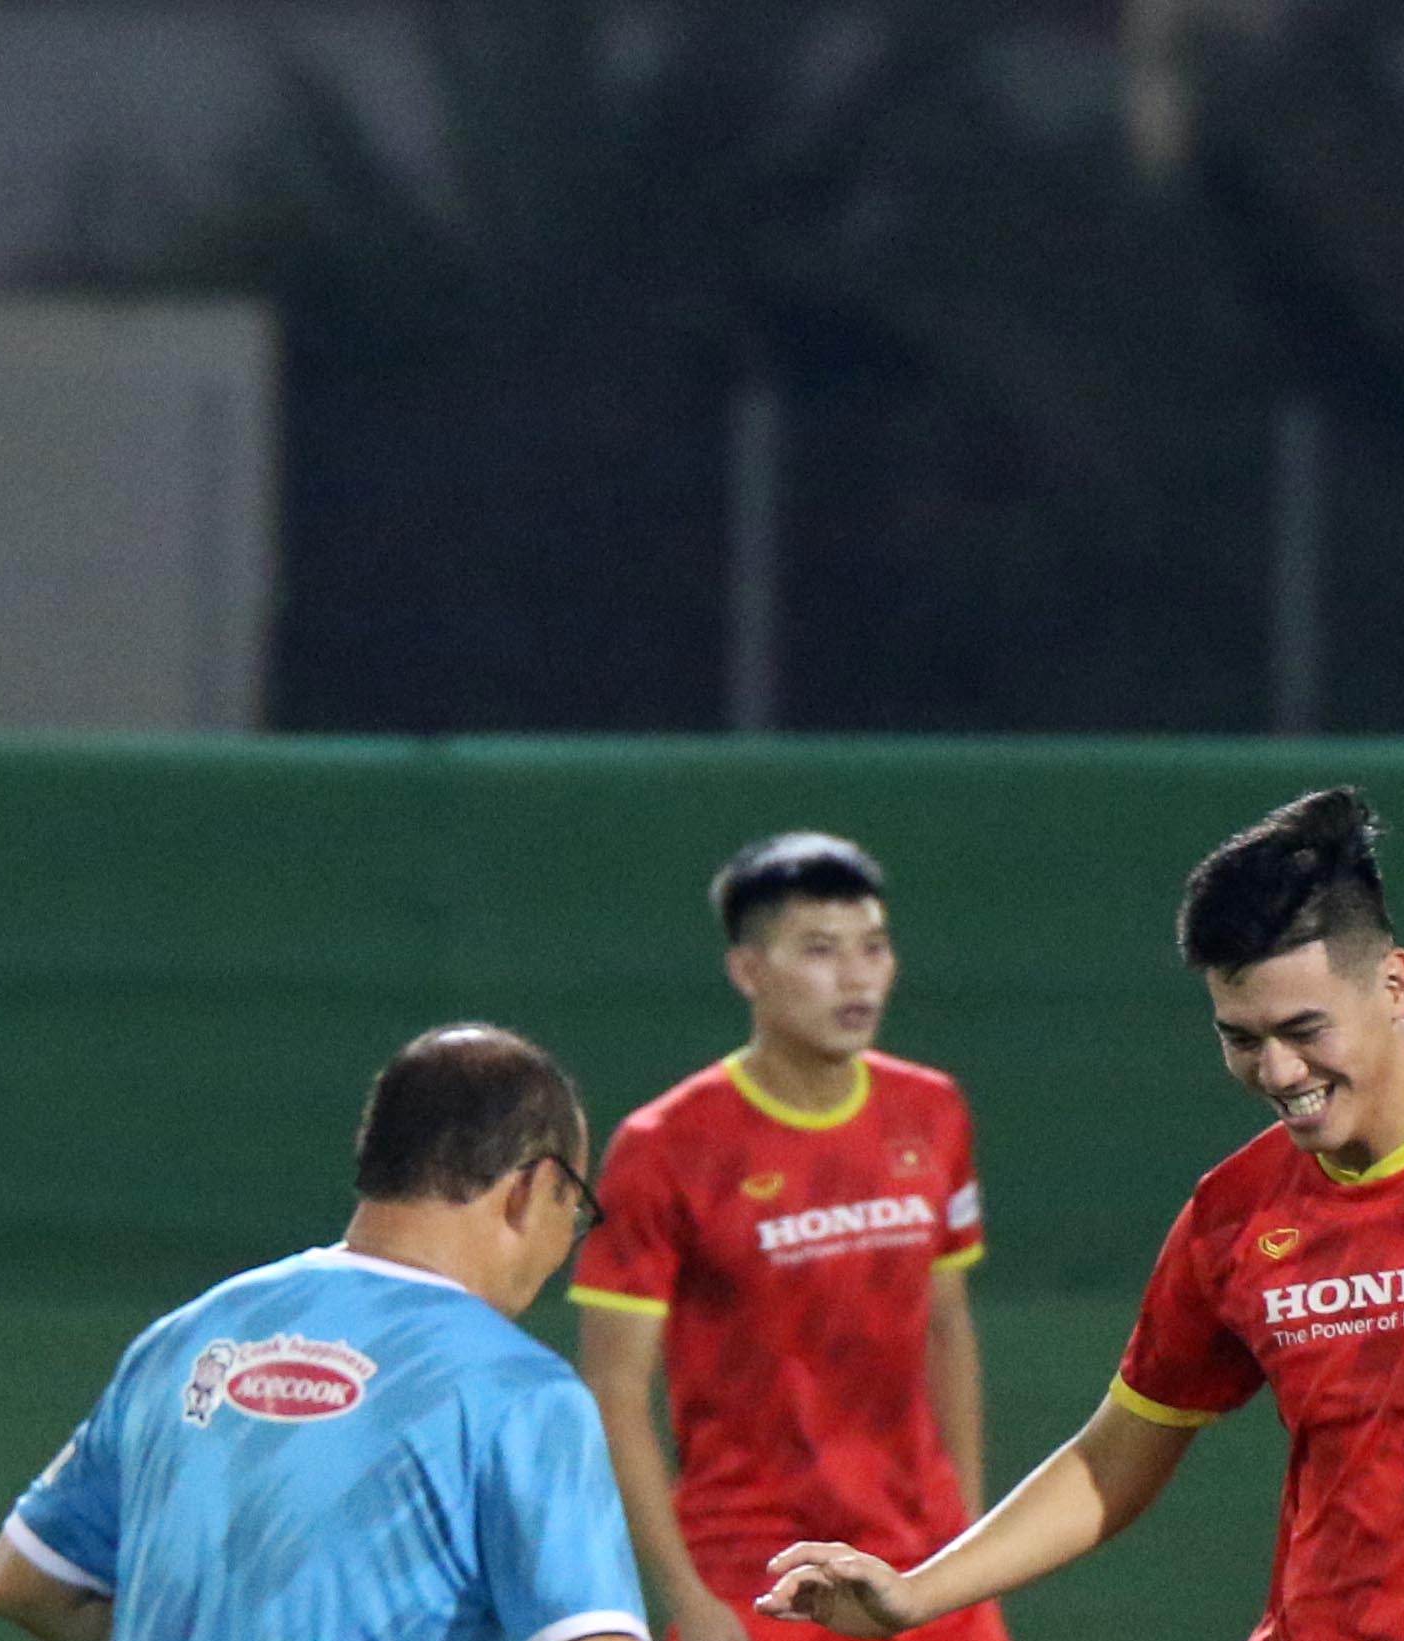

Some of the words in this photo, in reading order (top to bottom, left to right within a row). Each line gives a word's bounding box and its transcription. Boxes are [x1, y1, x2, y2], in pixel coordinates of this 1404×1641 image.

[756, 1195, 933, 1250] HONDA
[1273, 1328, 1307, 1347] The
[1311, 1318, 1373, 1339] Power
[1377, 1314, 1398, 1332] of
